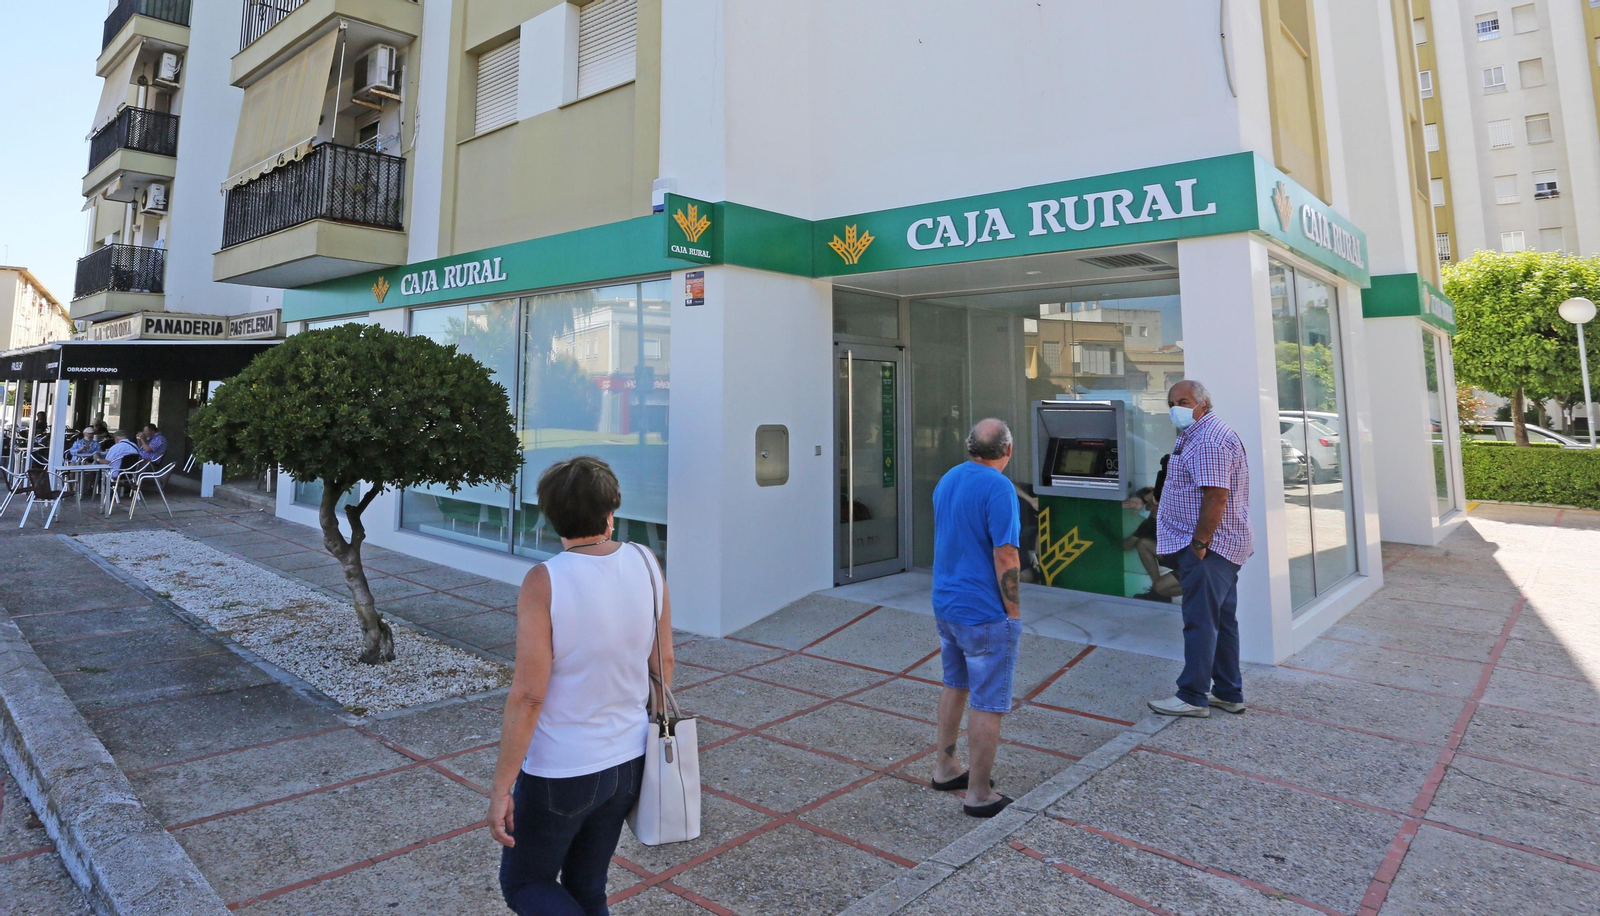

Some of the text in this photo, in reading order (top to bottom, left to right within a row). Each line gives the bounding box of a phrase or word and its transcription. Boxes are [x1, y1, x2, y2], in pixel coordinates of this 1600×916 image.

[906, 178, 1217, 250] CAJA RURAL
[671, 244, 711, 258] CAJA RURAL
[1302, 204, 1365, 270] CAJA RURAL
[400, 257, 506, 295] CAJA RURAL
[144, 318, 223, 336] PANADERIA
[229, 315, 273, 336] PASTELERIA
